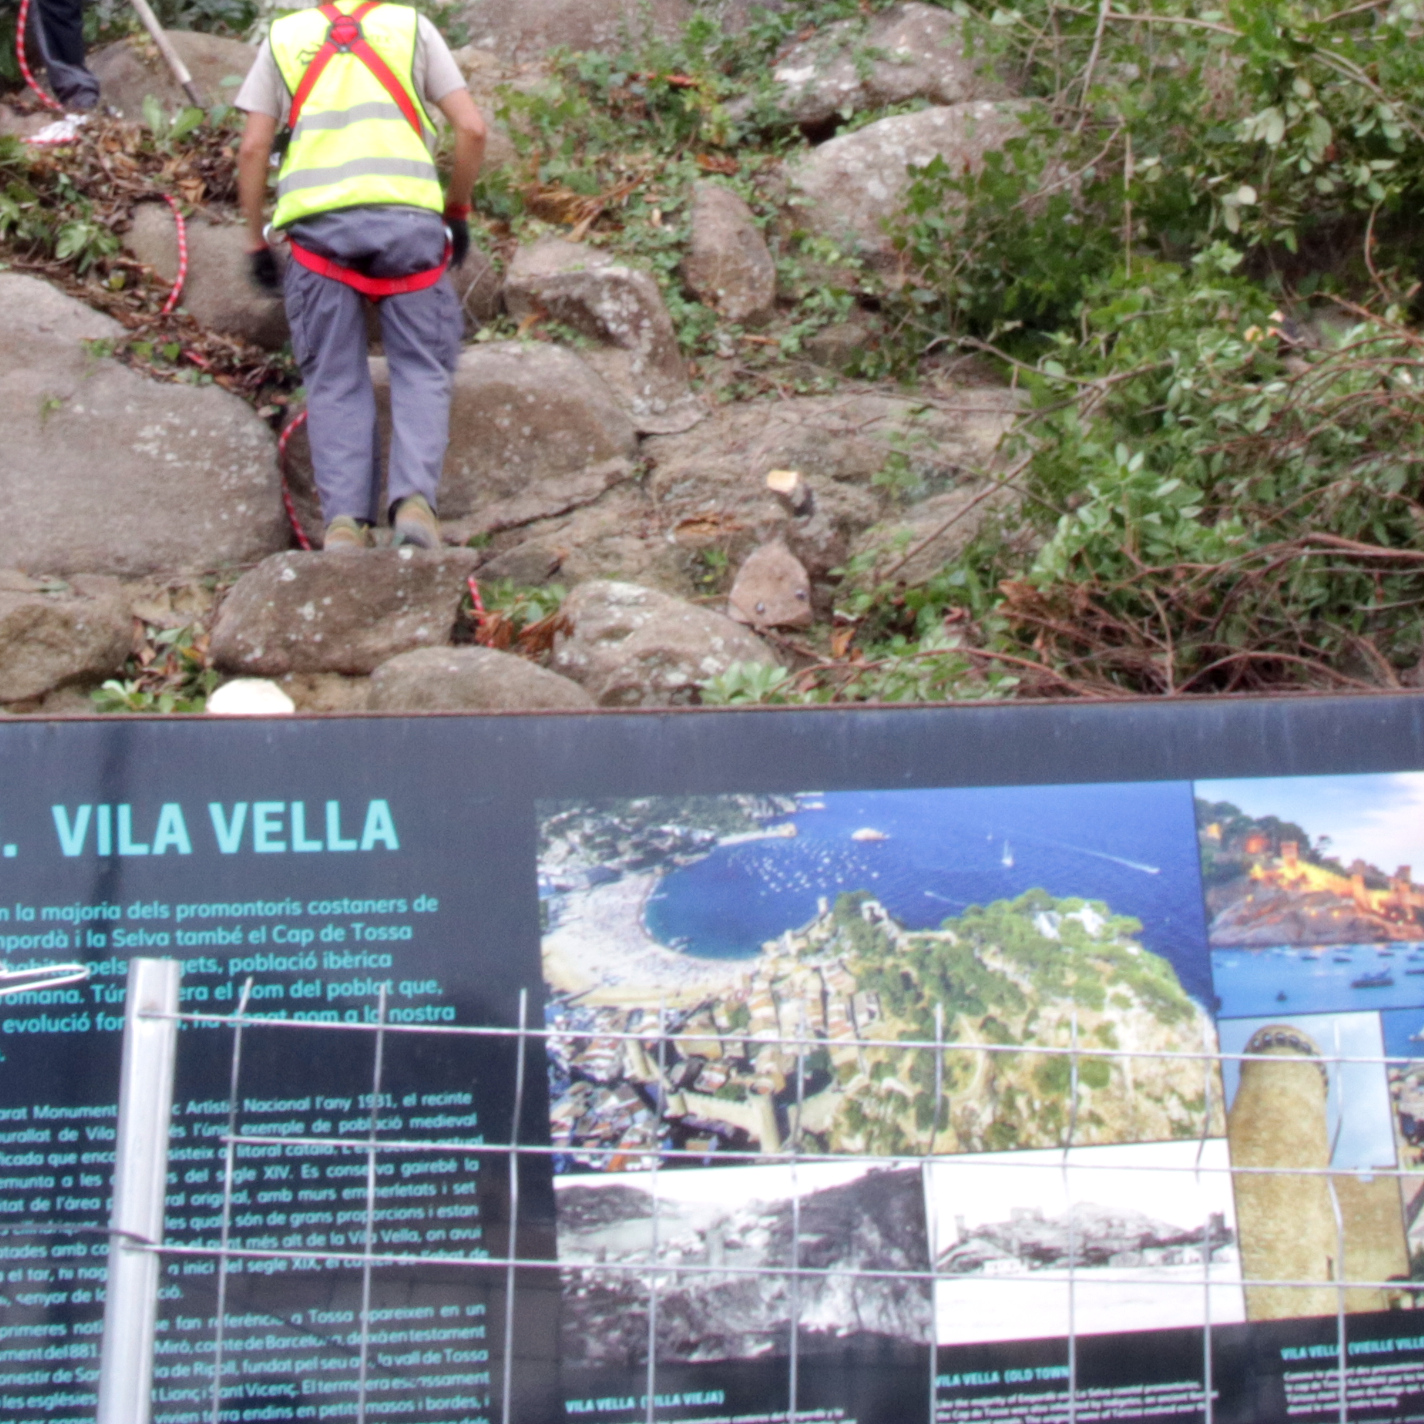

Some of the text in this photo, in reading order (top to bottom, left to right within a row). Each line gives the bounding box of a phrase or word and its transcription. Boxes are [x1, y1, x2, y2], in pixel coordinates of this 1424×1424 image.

[51, 802, 192, 857] VILA
[208, 798, 400, 854] VELLA
[14, 903, 35, 922] la
[41, 901, 122, 925] majoria
[127, 900, 170, 920] dels
[176, 897, 303, 923] promontoris
[307, 897, 408, 915] costaners
[412, 894, 439, 913] de
[75, 929, 82, 947] i
[86, 929, 107, 947] la
[112, 928, 170, 947] Selva
[176, 926, 243, 946] també
[247, 926, 267, 943] el
[272, 924, 314, 947] Cap
[319, 923, 345, 942] de
[351, 922, 413, 941] Tossa
[85, 956, 126, 979] pels
[228, 950, 318, 976] població
[322, 949, 393, 970] ibèrica
[214, 980, 233, 1000] el
[289, 979, 322, 999] del
[398, 978, 444, 999] que,
[2, 1011, 91, 1034] evolució
[344, 1008, 359, 1024] a
[388, 1004, 456, 1023] nostra
[32, 1103, 118, 1120] Monument
[243, 1096, 312, 1113] Nacional
[402, 1092, 418, 1108] el
[421, 1090, 473, 1107] recinte
[57, 1126, 79, 1143] de
[84, 1125, 117, 1141] Vila
[240, 1120, 306, 1137] exemple
[311, 1118, 333, 1134] de
[409, 1112, 478, 1129] medieval
[47, 1151, 78, 1168] que
[236, 1143, 282, 1159] litoral
[61, 1176, 74, 1188] a
[79, 1172, 103, 1188] les
[184, 1168, 210, 1185] del
[263, 1164, 294, 1180] XIV.
[300, 1162, 320, 1179] Es
[400, 1157, 459, 1178] gairebé
[463, 1156, 480, 1172] la
[29, 1196, 51, 1212] de
[257, 1187, 293, 1204] amb
[297, 1187, 337, 1202] murs
[441, 1180, 448, 1195] i
[452, 1180, 476, 1195] set
[234, 1210, 264, 1227] són
[266, 1210, 287, 1226] de
[289, 1211, 334, 1228] grans
[428, 1205, 435, 1218] i
[436, 1204, 480, 1219] estan
[51, 1241, 88, 1258] amb
[245, 1233, 279, 1249] més
[282, 1232, 303, 1249] alt
[305, 1232, 327, 1248] de
[329, 1230, 345, 1247] la
[379, 1227, 423, 1243] Vella,
[425, 1228, 446, 1243] on
[449, 1226, 483, 1241] avui
[7, 1268, 23, 1282] el
[183, 1261, 216, 1275] inici
[247, 1256, 289, 1276] segle
[71, 1287, 93, 1304] de
[175, 1314, 203, 1331] fan
[290, 1312, 304, 1326] a
[308, 1307, 355, 1325] Tossa
[439, 1304, 461, 1318] en
[465, 1303, 487, 1317] un
[43, 1344, 69, 1361] del
[244, 1335, 265, 1351] de
[388, 1329, 408, 1344] en
[409, 1324, 486, 1343] testament
[1280, 1344, 1308, 1361] VILA
[51, 1367, 74, 1384] de
[170, 1362, 192, 1377] de
[242, 1358, 293, 1375] fundat
[294, 1355, 320, 1375] pel
[320, 1355, 348, 1371] seu
[421, 1350, 443, 1366] de
[443, 1347, 490, 1363] Tossa
[962, 1371, 1001, 1387] VELLA
[2, 1393, 26, 1410] les
[364, 1376, 391, 1391] era
[565, 1398, 595, 1414] VILA
[596, 1395, 636, 1413] VELLA
[296, 1406, 317, 1419] en
[364, 1399, 416, 1414] masos
